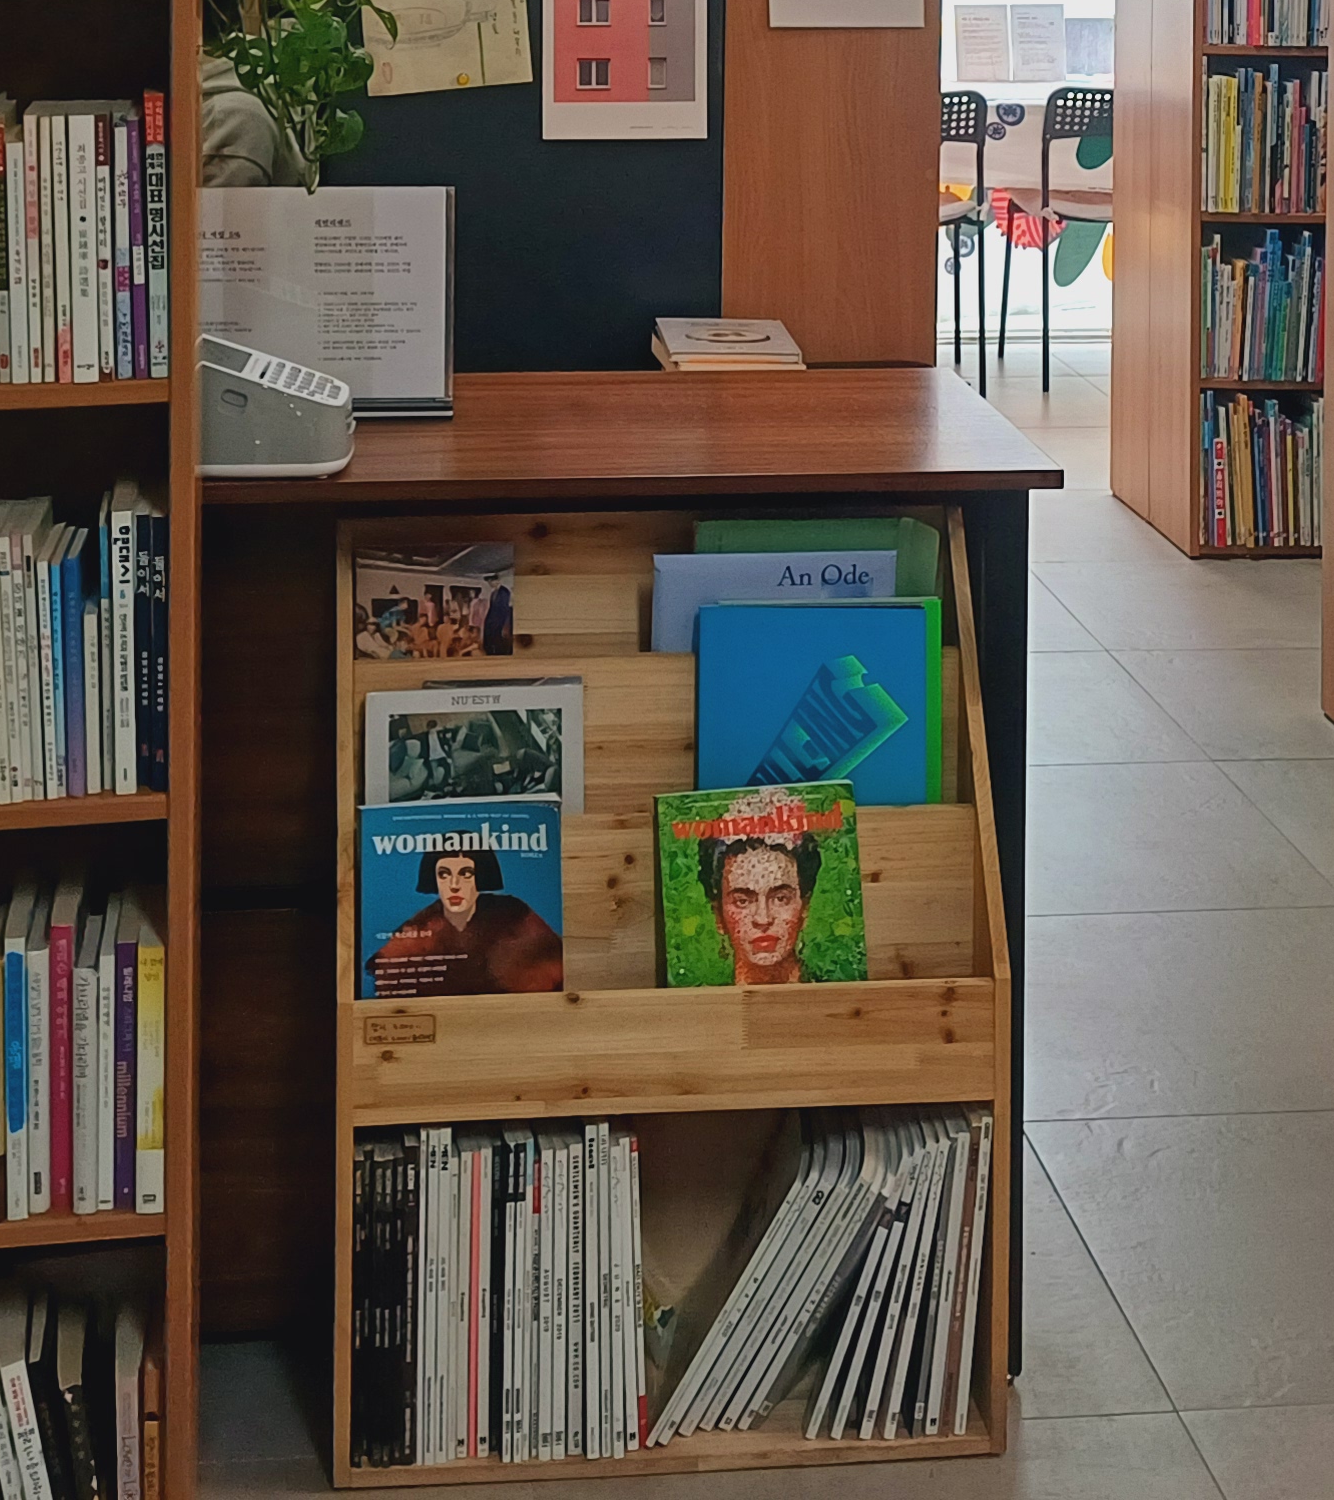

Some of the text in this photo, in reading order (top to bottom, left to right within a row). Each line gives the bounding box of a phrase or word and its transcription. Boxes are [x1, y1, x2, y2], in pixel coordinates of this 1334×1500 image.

[148, 173, 165, 270] 대표 명시선집
[113, 524, 131, 584] 현대시
[777, 563, 870, 588] An Ode
[372, 822, 548, 855] womankind
[671, 803, 842, 841] womankind
[74, 975, 90, 1079] 가브리엘을 기다리며
[116, 1061, 128, 1138] millennium
[441, 1143, 449, 1171] MEN
